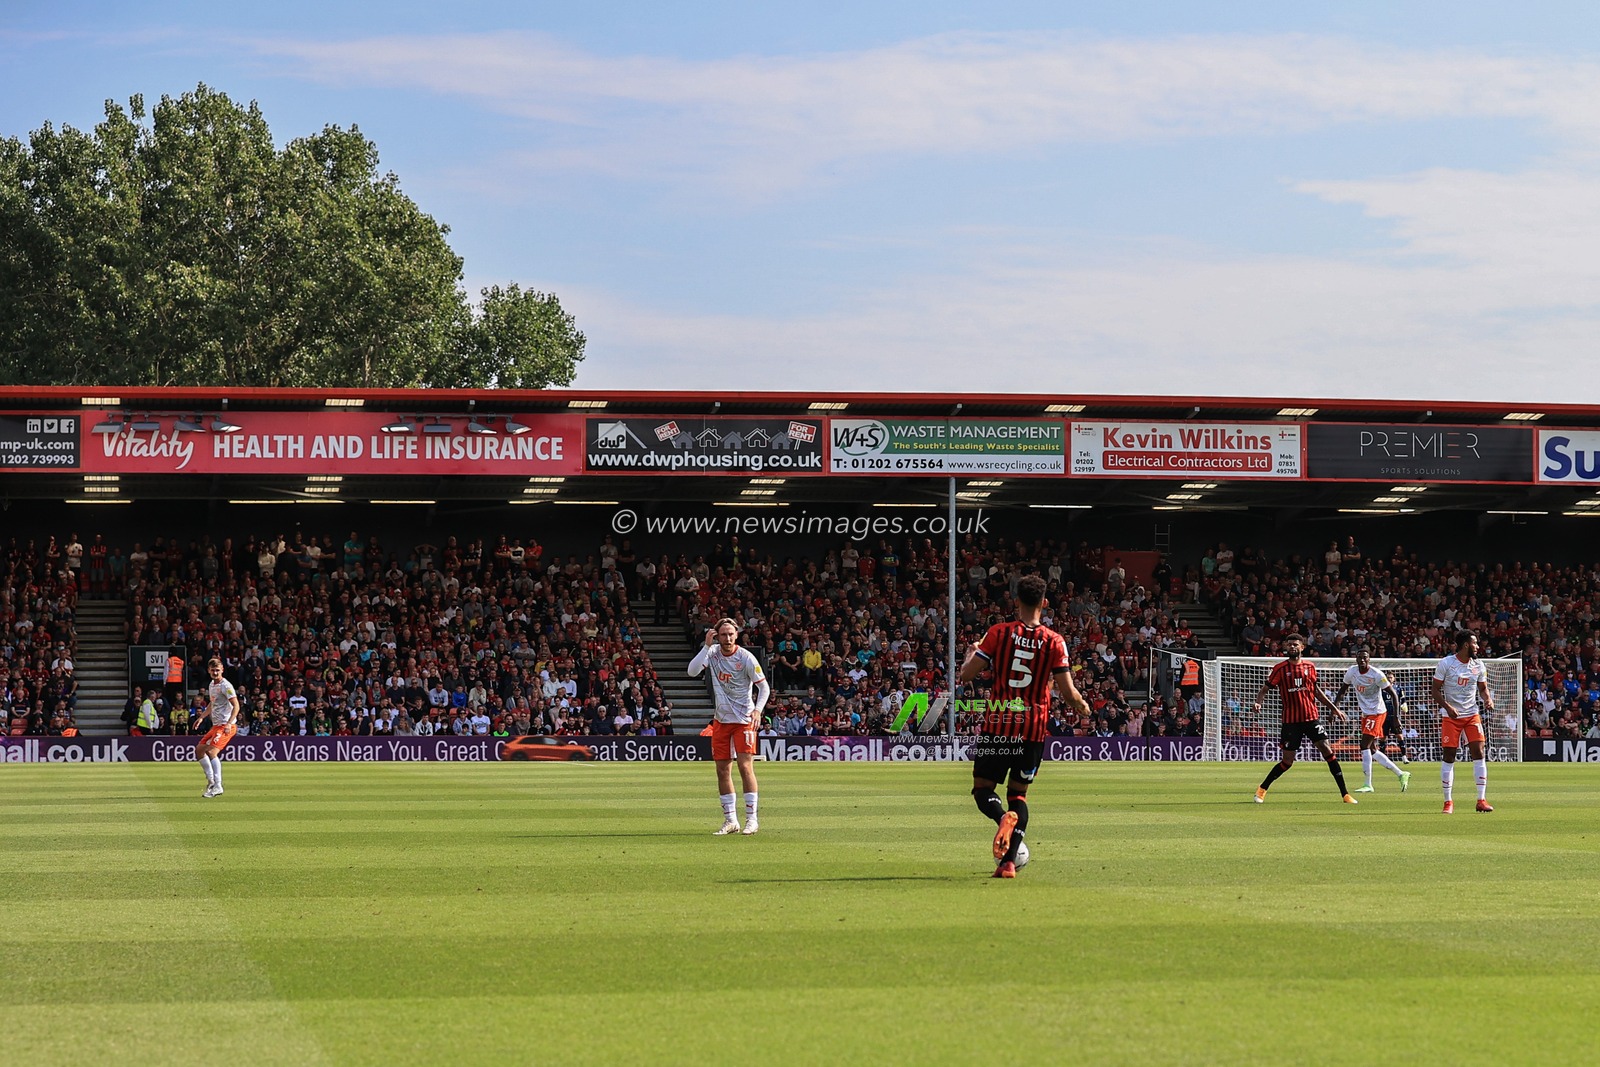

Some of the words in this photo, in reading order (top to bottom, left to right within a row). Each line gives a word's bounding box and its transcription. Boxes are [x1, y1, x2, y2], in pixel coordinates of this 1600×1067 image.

[656, 424, 670, 434] FOR
[660, 429, 678, 440] RENT
[788, 430, 813, 440] RENT
[790, 424, 808, 433] FOR
[892, 425, 945, 438] WASTE
[950, 426, 1060, 438] MANAGEMENT
[0, 438, 74, 452] mp-uk.com
[834, 428, 880, 448] W+S
[1103, 427, 1173, 448] Kevin
[1178, 428, 1272, 450] Wilkins
[1360, 431, 1480, 458] PREMIER
[103, 430, 194, 470] Vitality
[213, 435, 304, 458] HEALTH
[310, 436, 364, 458] AND
[370, 436, 418, 460] LIFE
[425, 436, 564, 460] INSURANCE
[893, 442, 910, 450] The
[913, 442, 946, 450] South's
[949, 443, 984, 452] Leading
[1017, 444, 1060, 452] Specialist
[32, 454, 74, 464] 739993
[588, 450, 822, 470] www.dwphousing.co.uk
[833, 458, 848, 468] T:
[851, 458, 892, 468] 01202
[896, 458, 944, 468] 675564
[948, 460, 1062, 472] www.wsrecycling.co.uk
[1108, 454, 1164, 467] Electrical
[1168, 455, 1243, 468] Contractors
[1247, 456, 1268, 468] Ltd
[1014, 636, 1044, 650] KELLY
[150, 654, 164, 664] SV1
[1008, 648, 1035, 688] 5
[152, 740, 197, 762] Grea
[220, 744, 255, 762] ars
[262, 740, 277, 762] &
[282, 740, 330, 761] Vans
[336, 740, 382, 761] Near
[388, 740, 428, 761] You.
[435, 740, 488, 761] Great
[624, 740, 702, 761] Service.
[760, 738, 970, 762] Marshall.co.uk
[1050, 741, 1092, 761] Cars
[1098, 742, 1112, 761] &
[1118, 742, 1162, 761] Vans
